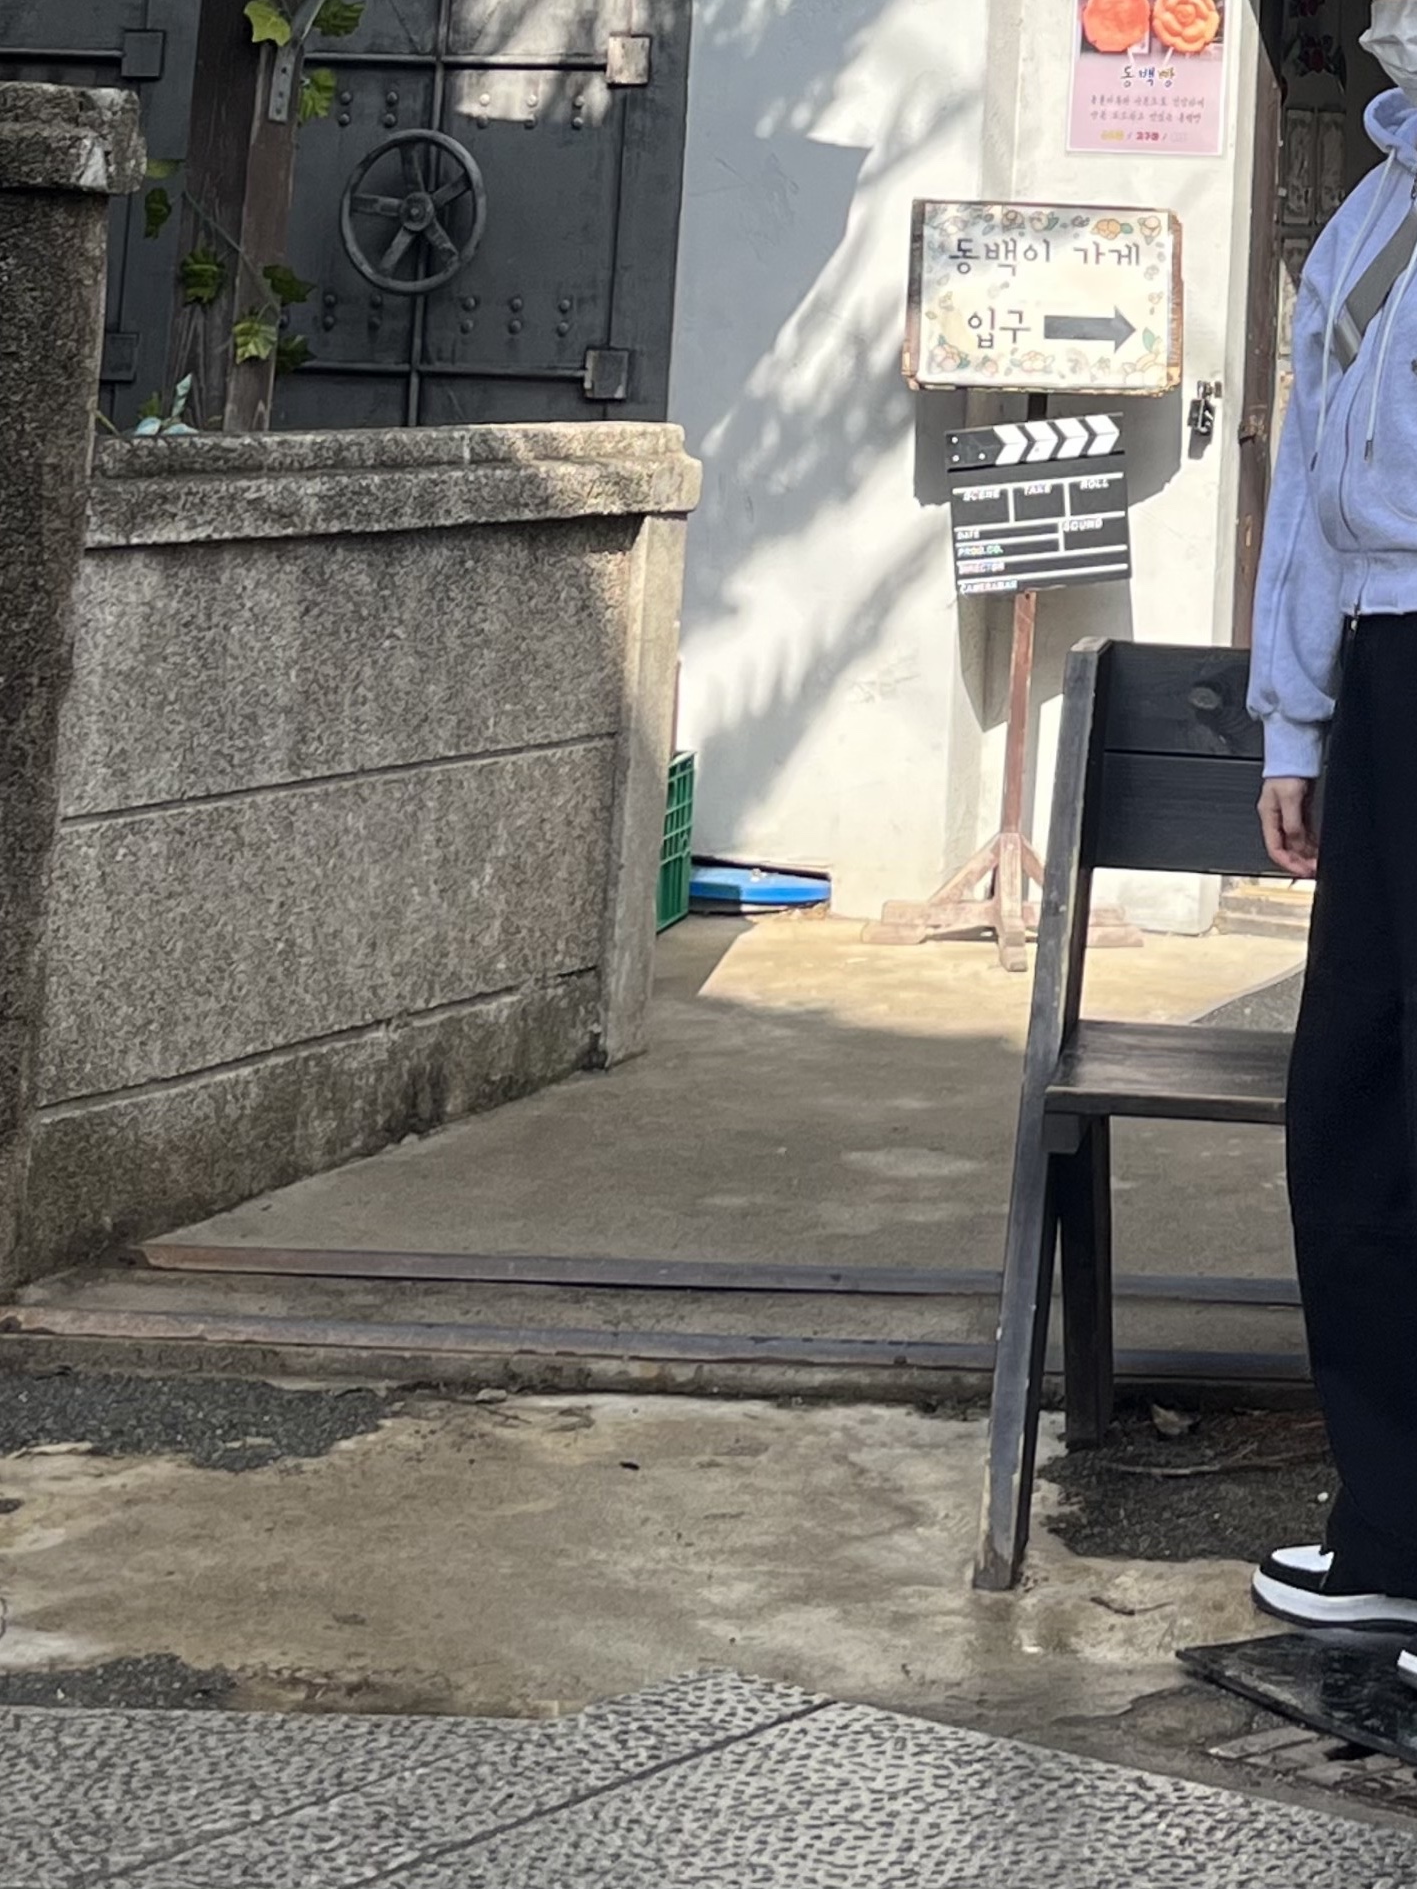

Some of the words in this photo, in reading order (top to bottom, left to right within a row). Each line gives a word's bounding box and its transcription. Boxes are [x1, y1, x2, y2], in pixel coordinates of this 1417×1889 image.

[948, 238, 1051, 277] 동백이
[1072, 241, 1140, 267] 가게
[967, 307, 1032, 350] 입구
[1023, 484, 1052, 496] TAKE
[1079, 478, 1110, 491] ROLL
[1063, 517, 1104, 532] SOUND
